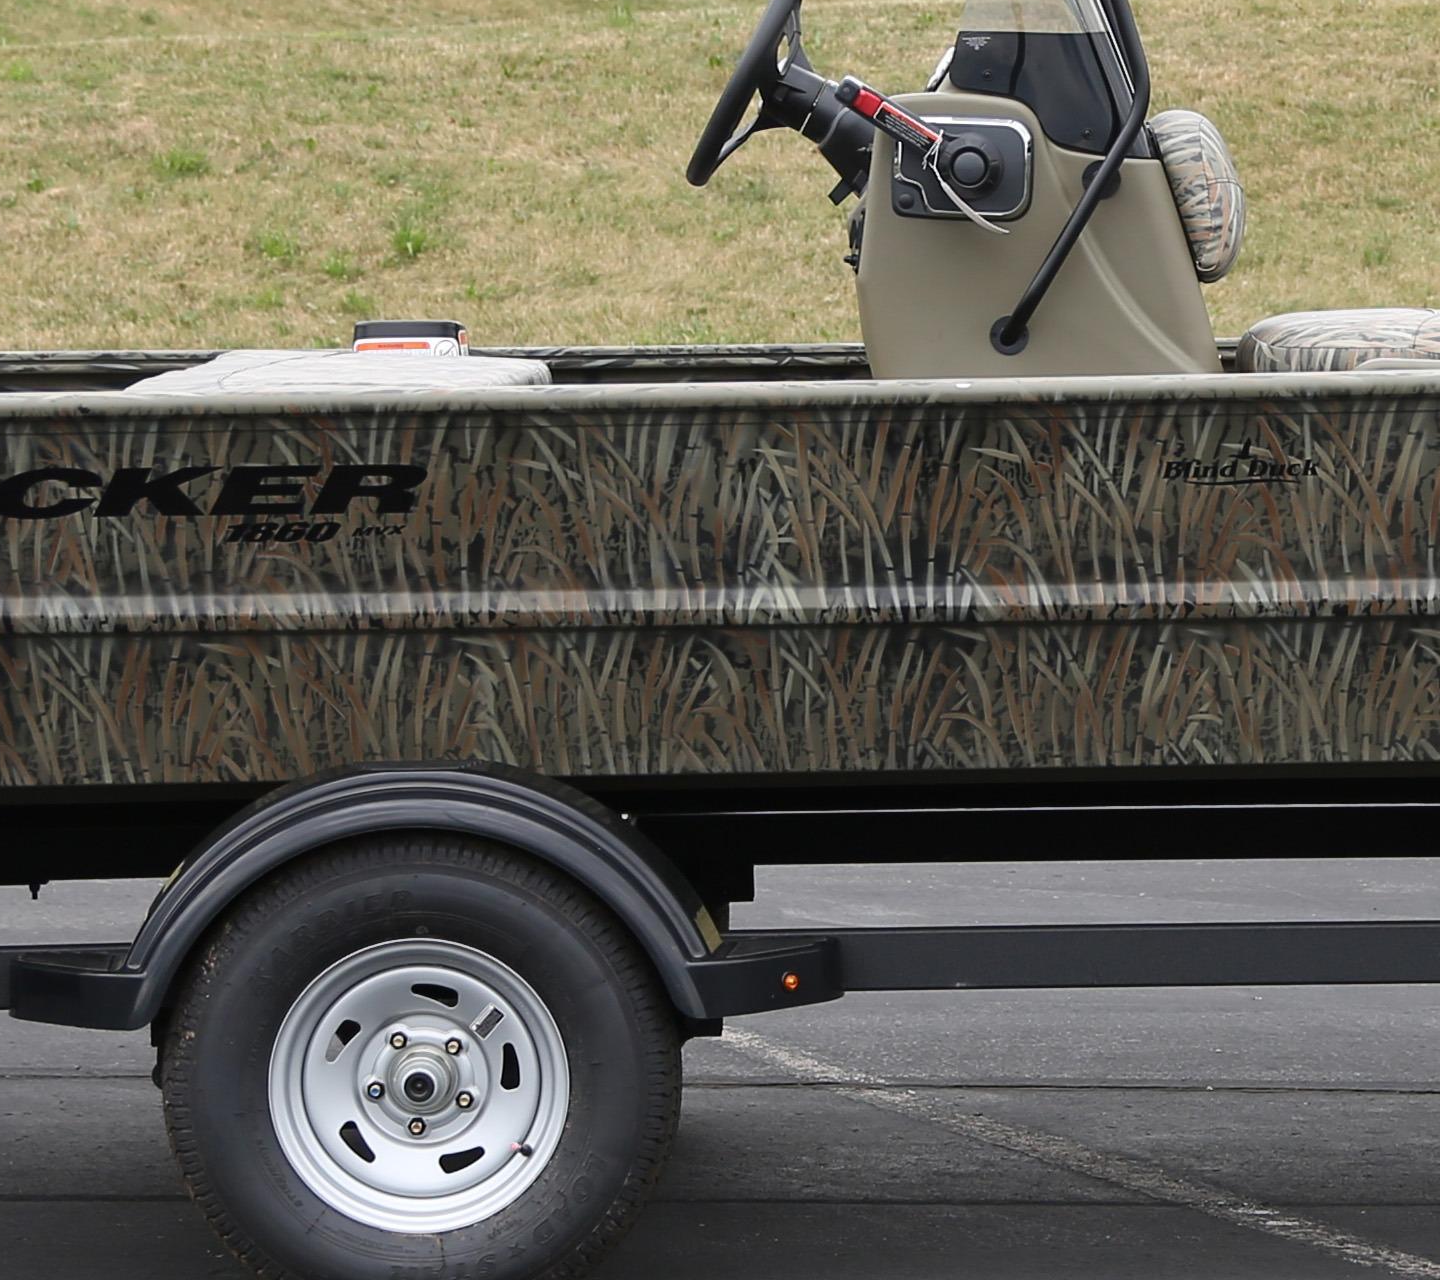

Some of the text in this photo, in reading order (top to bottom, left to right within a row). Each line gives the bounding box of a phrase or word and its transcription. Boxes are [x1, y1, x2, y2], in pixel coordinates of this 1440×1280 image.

[1162, 457, 1319, 481] Blind Duck
[224, 522, 406, 543] 1860 MVX
